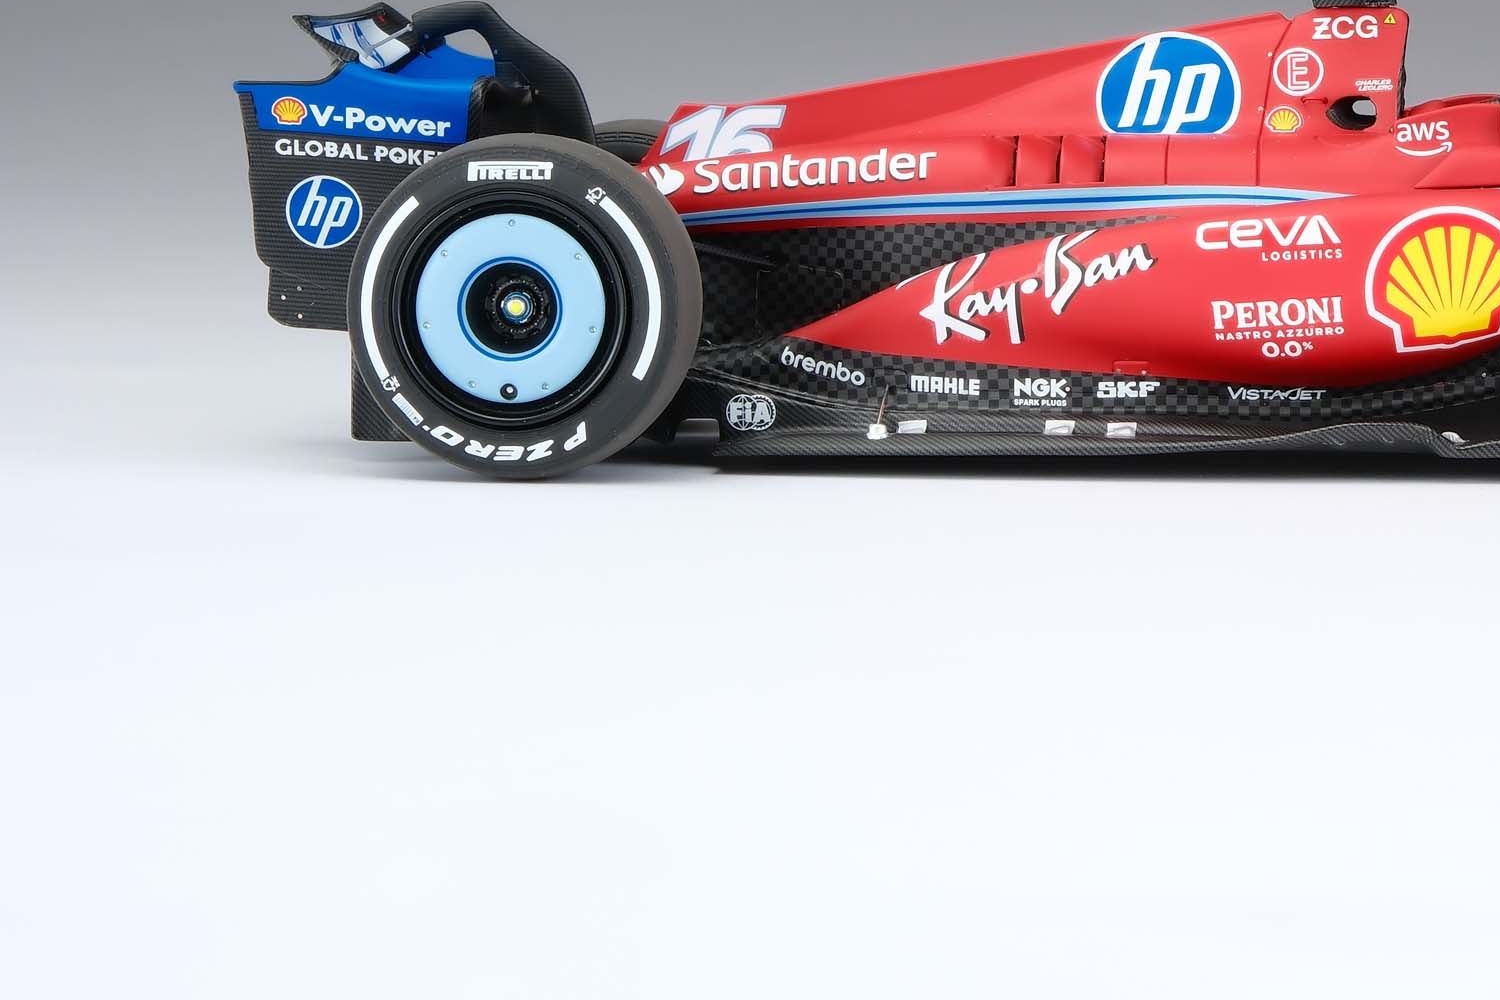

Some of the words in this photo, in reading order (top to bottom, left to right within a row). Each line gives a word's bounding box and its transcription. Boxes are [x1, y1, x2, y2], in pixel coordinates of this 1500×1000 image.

[1312, 15, 1378, 39] ZCG
[1117, 35, 1221, 134] hp
[309, 104, 451, 137] V-Power
[660, 105, 787, 161] 16
[1396, 120, 1450, 143] aws
[275, 138, 368, 161] GLOBAL
[374, 145, 442, 166] POKE
[467, 161, 554, 181] PIRELLI
[693, 148, 937, 194] Santander
[297, 177, 353, 248] hp
[1261, 249, 1343, 262] LOGISTICS
[1211, 296, 1344, 330] PERONI
[1215, 330, 1272, 341] NASTRO
[1276, 327, 1345, 338] AZZURRO
[1261, 340, 1314, 358] 0.0%
[780, 345, 866, 386] brembo
[910, 375, 981, 396] MAHLE
[1096, 381, 1161, 399] SKF
[1041, 399, 1067, 407] PLUGS
[563, 421, 587, 451] P
